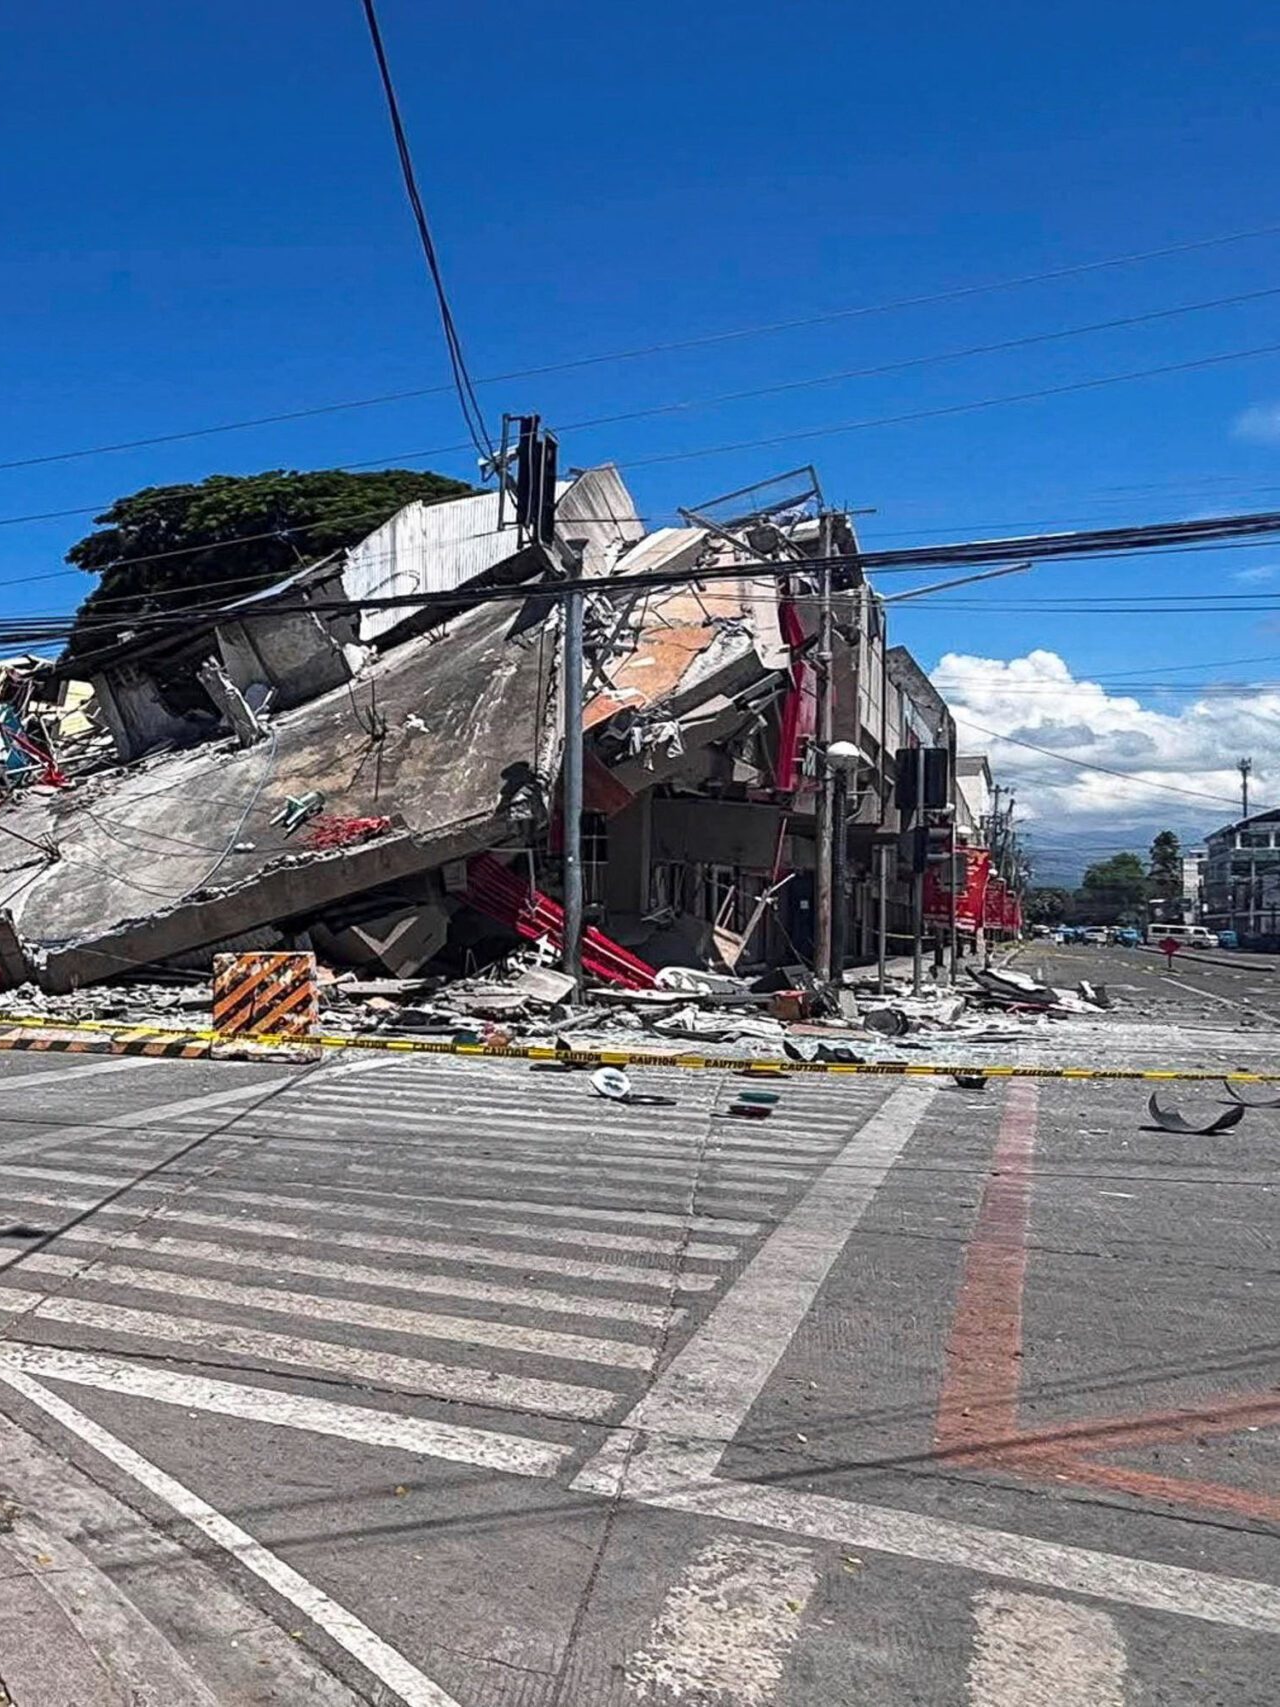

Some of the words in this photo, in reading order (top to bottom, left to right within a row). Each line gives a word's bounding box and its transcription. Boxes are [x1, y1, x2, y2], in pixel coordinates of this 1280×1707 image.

[555, 1051, 601, 1062] CAUTION
[628, 1055, 677, 1067] CAUTION
[704, 1059, 753, 1070] CAUTION
[780, 1062, 828, 1072] CAUTION
[856, 1065, 906, 1074] CAUTION
[933, 1066, 984, 1076] CAUTION
[1011, 1069, 1064, 1077] CAUTION
